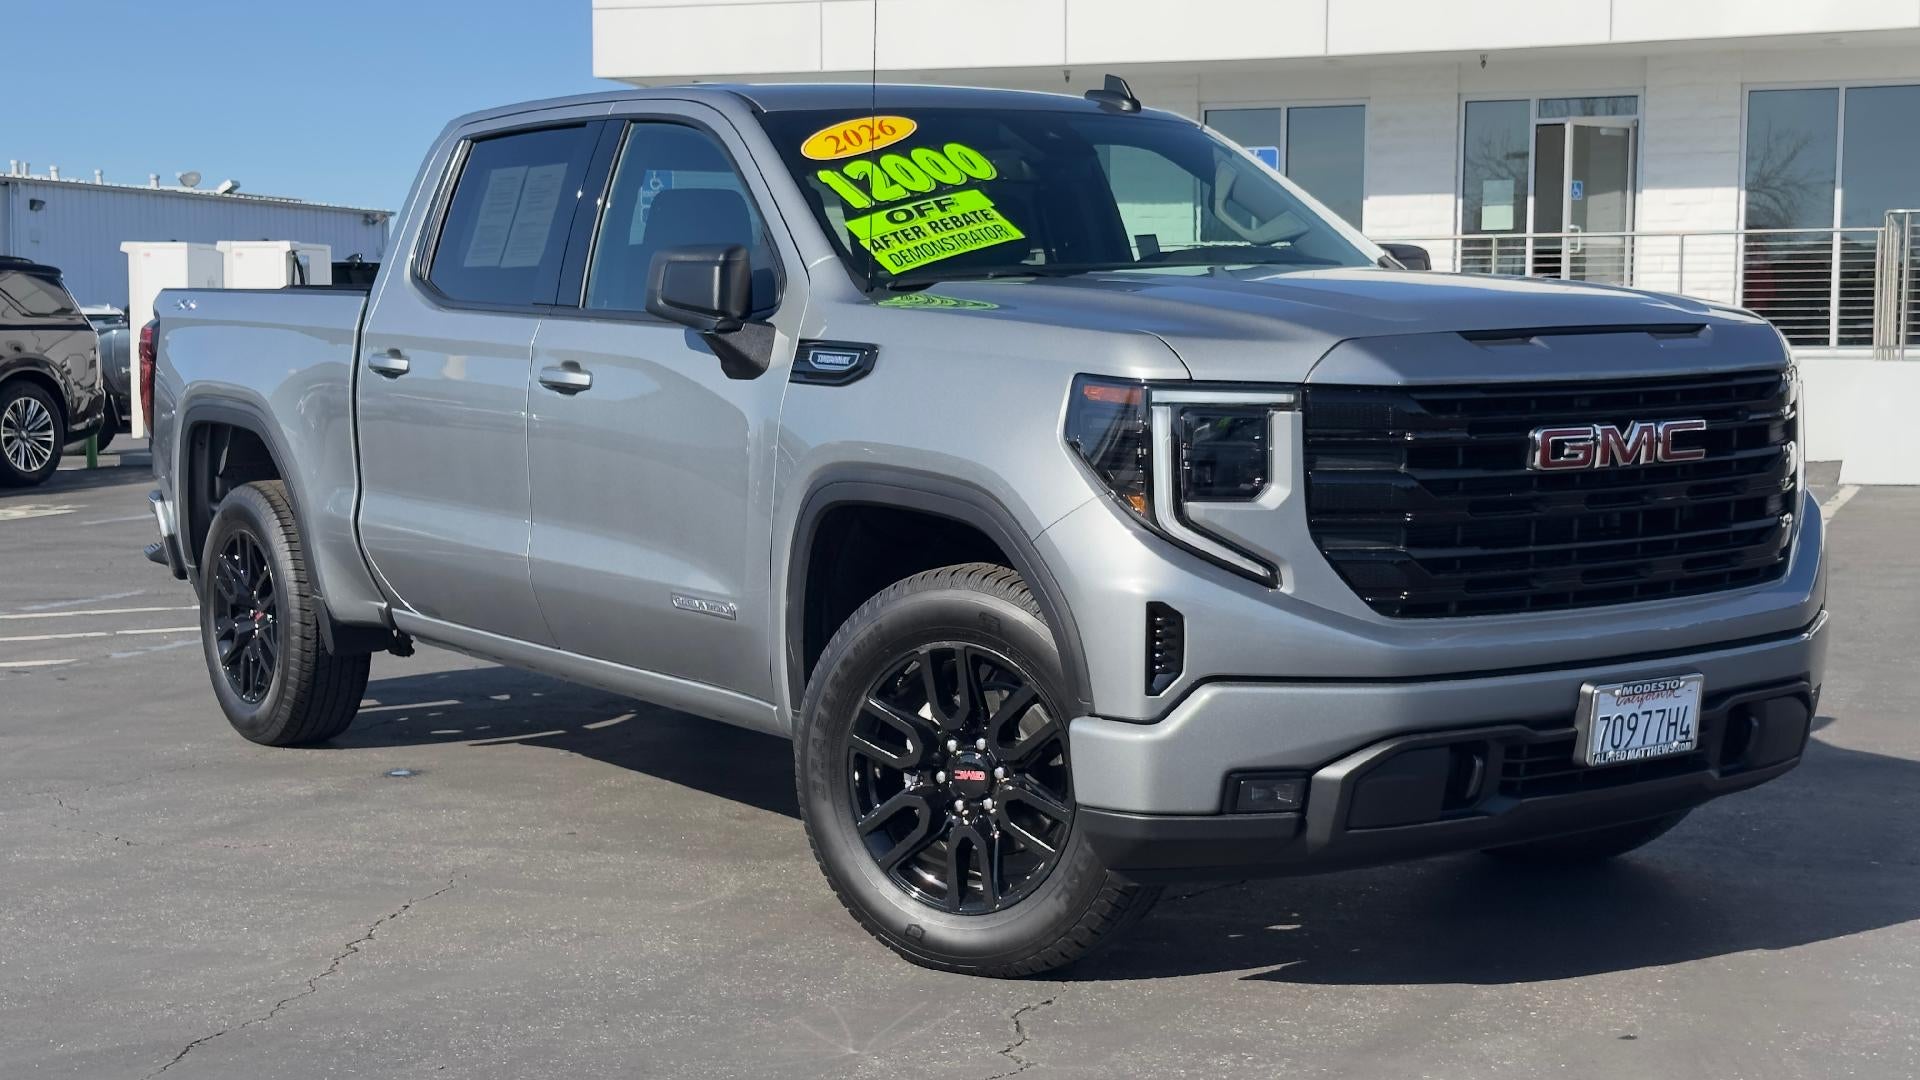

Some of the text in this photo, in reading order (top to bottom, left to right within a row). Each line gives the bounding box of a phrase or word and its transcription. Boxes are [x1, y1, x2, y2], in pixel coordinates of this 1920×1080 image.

[824, 119, 897, 155] 2026
[817, 143, 998, 209] 12000
[870, 208, 995, 253] AFTER REBATE
[885, 196, 959, 225] OFF
[888, 224, 1010, 267] DEMONSTRATOR
[1527, 419, 1707, 471] GMC
[1622, 680, 1680, 696] MODESTO
[1599, 705, 1691, 752] 70977H4
